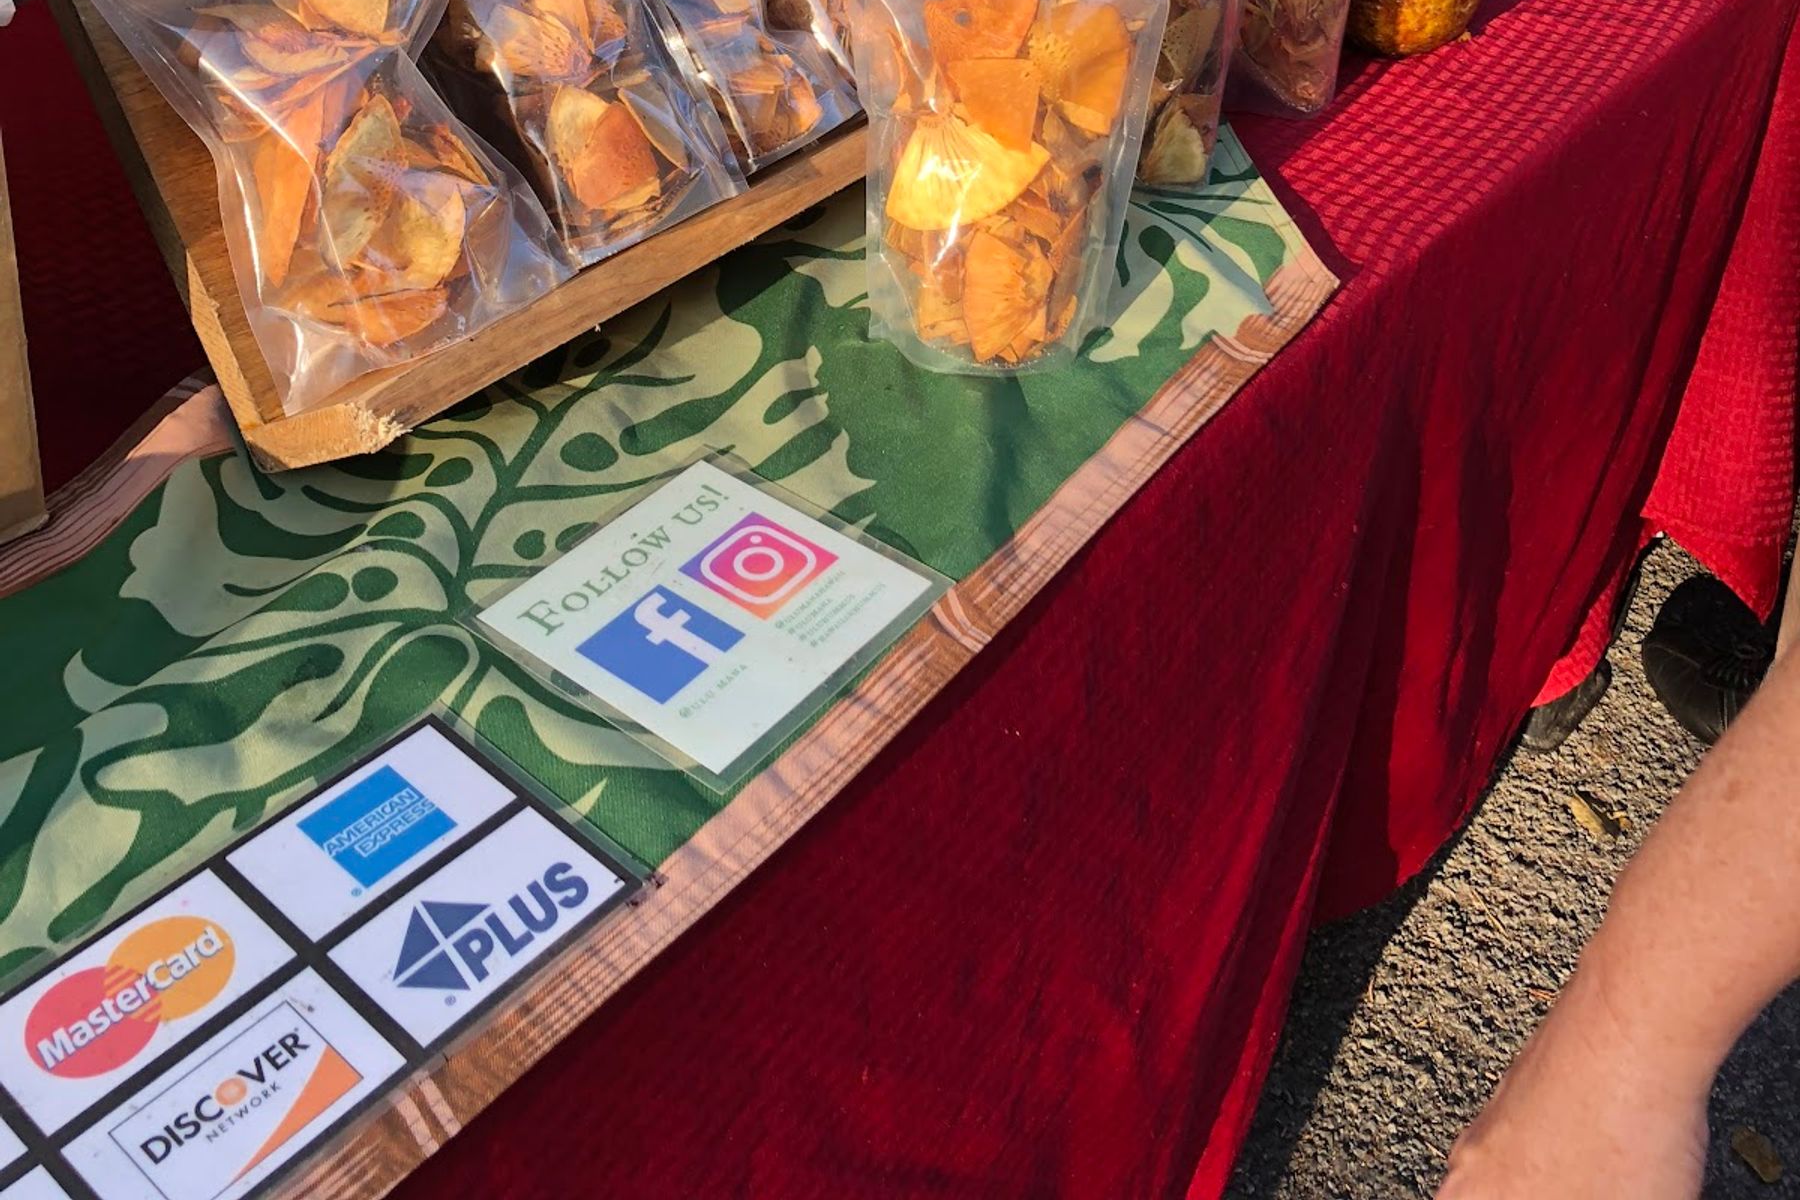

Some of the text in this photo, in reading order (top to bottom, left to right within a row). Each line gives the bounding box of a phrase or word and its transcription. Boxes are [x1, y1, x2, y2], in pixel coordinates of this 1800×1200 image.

[516, 483, 731, 637] FOLLOW US!
[323, 788, 417, 858] AMERICAN
[358, 798, 439, 859] EXPRESS
[459, 861, 590, 985] PLUS
[36, 927, 228, 1072] MasterCard
[139, 1031, 310, 1167] DISCOVER
[204, 1081, 283, 1145] NETWORK
